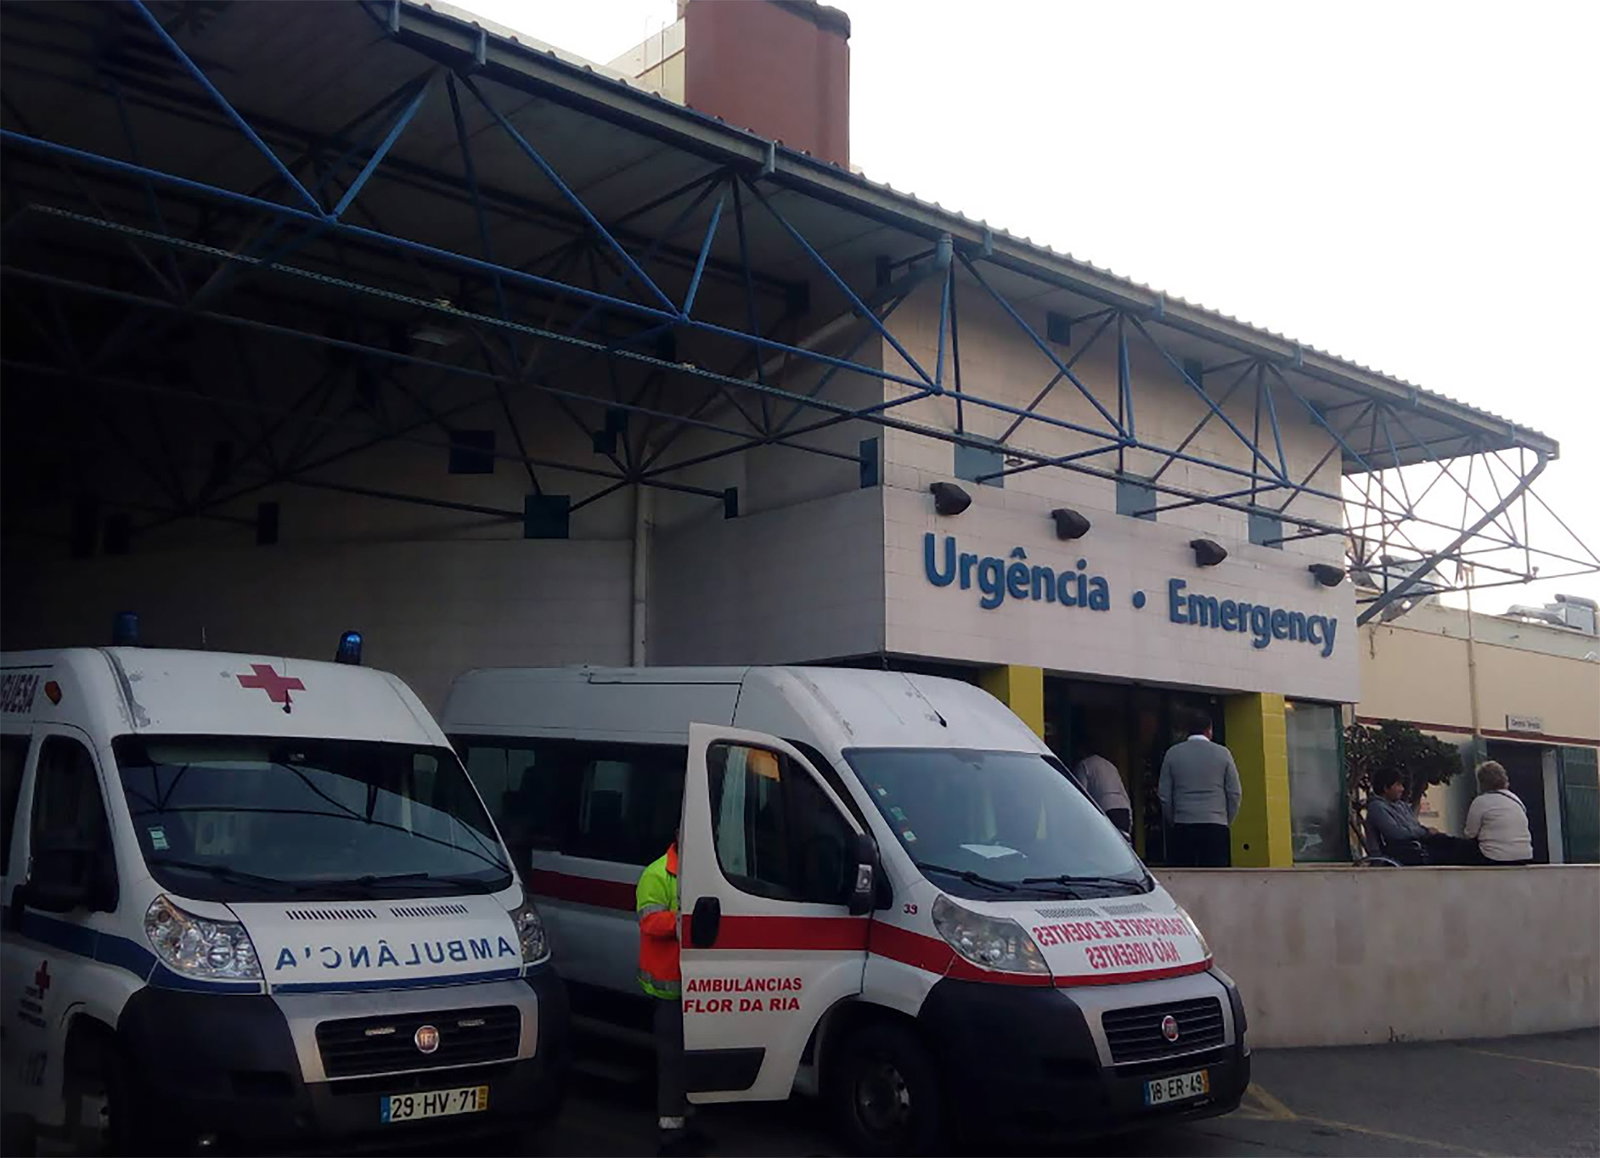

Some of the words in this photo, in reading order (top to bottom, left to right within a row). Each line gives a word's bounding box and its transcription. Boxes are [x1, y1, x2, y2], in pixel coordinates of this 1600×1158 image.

[924, 532, 1111, 611] Urgência
[1168, 578, 1338, 657] Emergency
[684, 999, 732, 1012] FLOR
[739, 999, 763, 1011] DA
[769, 997, 800, 1011] RIA
